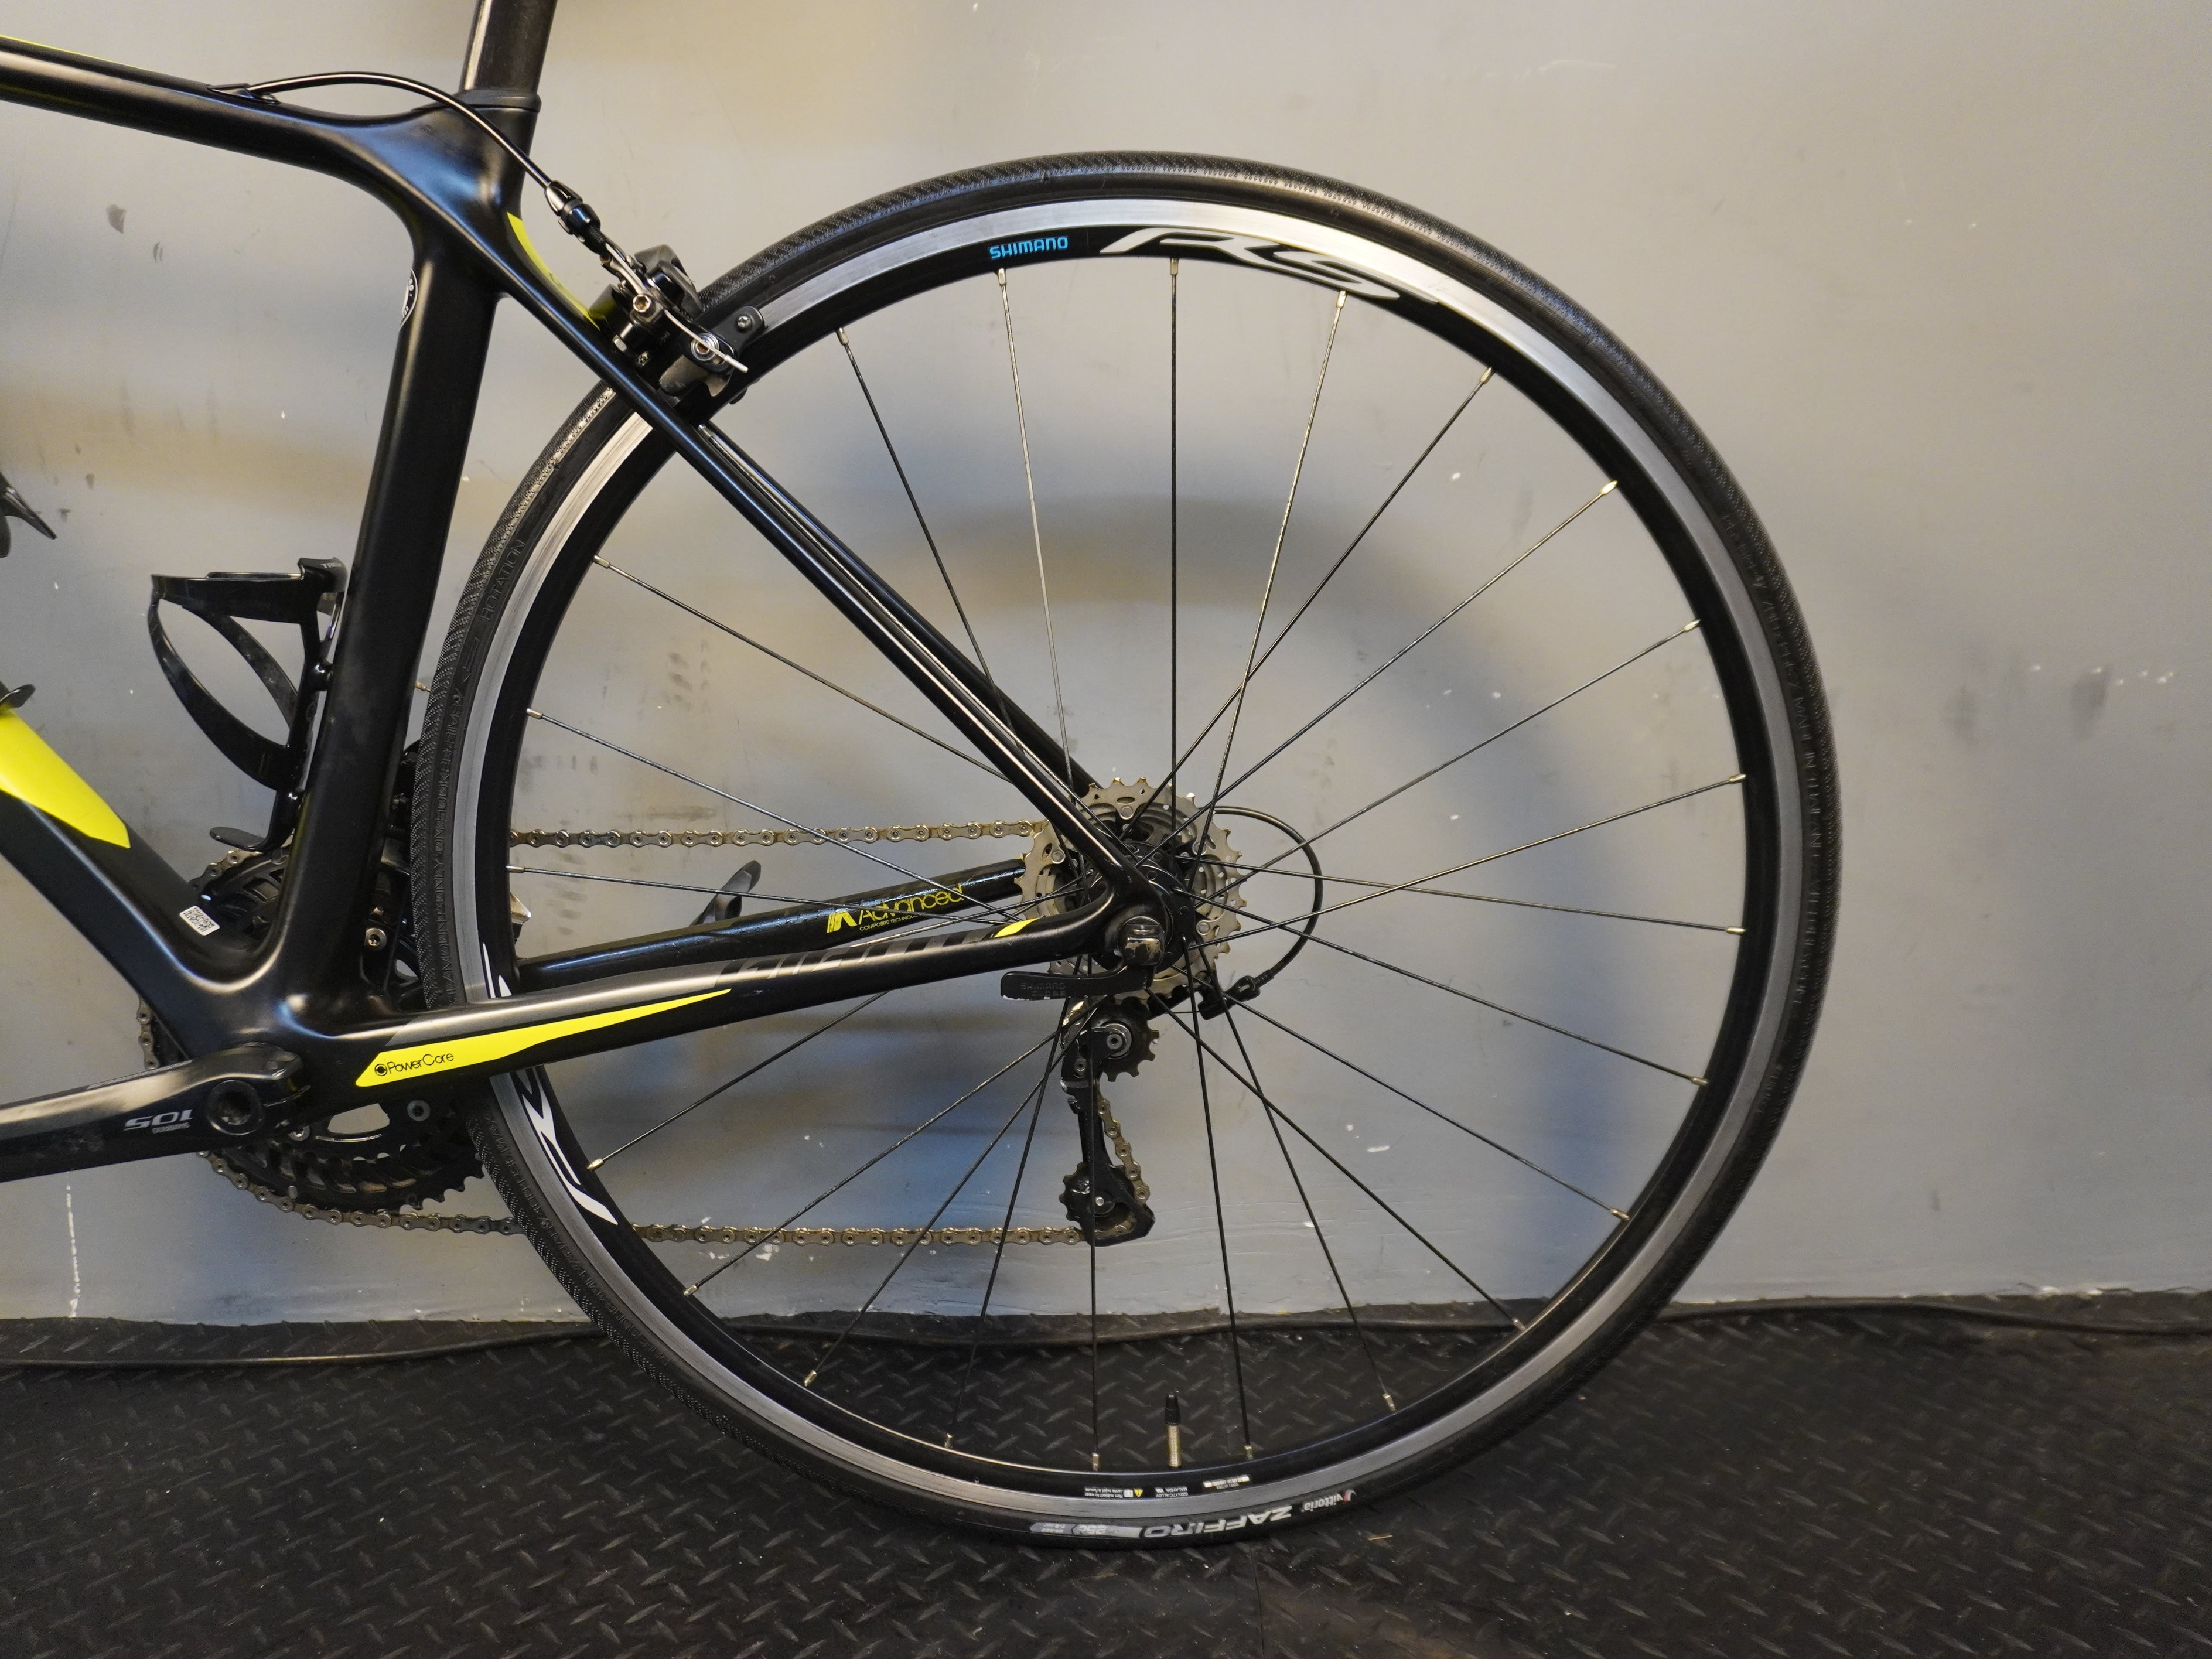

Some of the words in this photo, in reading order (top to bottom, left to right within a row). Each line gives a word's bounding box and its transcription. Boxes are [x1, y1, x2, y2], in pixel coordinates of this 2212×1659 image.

[989, 236, 1069, 260] SHIMANO
[1100, 227, 1439, 304] RS
[859, 883, 964, 925] Advanced
[859, 920, 890, 931] COMPOSITE
[387, 1053, 454, 1074] PowerCore
[123, 1109, 193, 1131] 105
[1302, 1491, 1345, 1512] vittoria
[1144, 1506, 1293, 1538] ZAFFIRO
